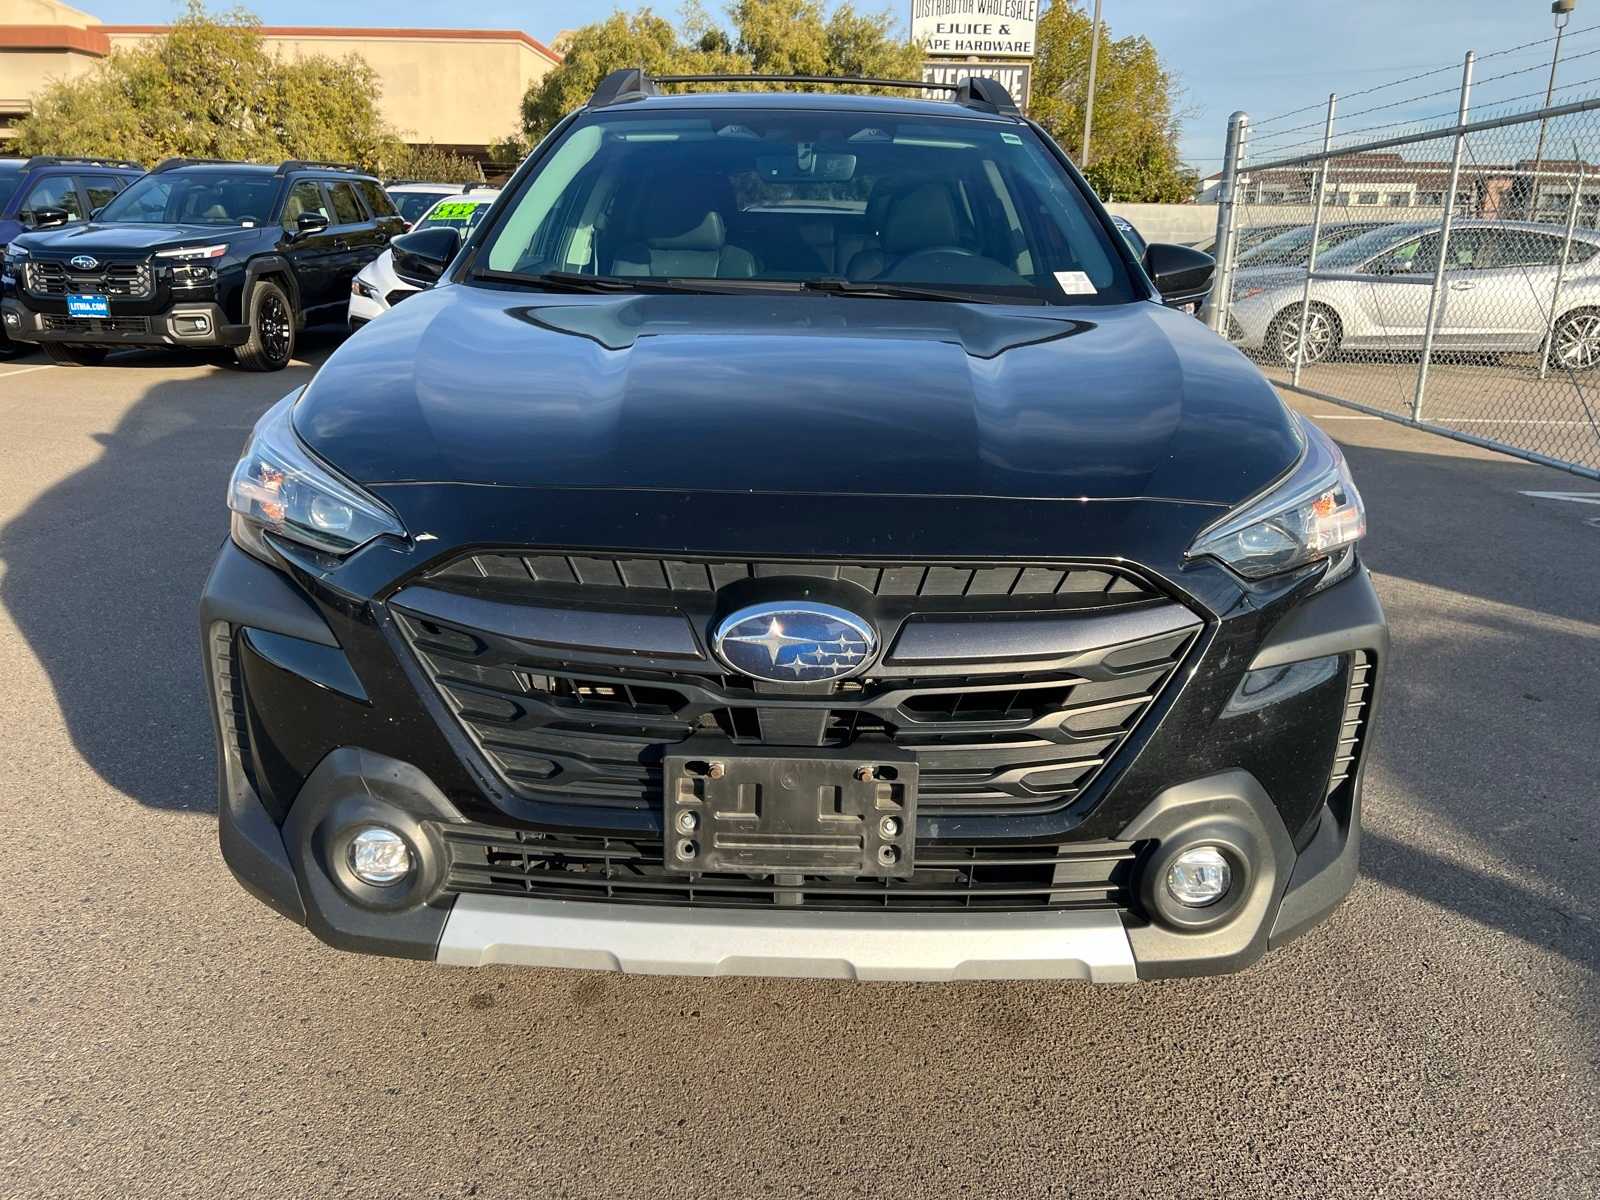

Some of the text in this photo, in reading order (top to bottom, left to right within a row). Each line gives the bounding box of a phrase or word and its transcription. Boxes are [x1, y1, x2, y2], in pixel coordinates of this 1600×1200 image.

[916, 0, 1035, 22] DISTRIBUTOR WHOLESALE
[936, 23, 1012, 36] EJUICE &
[955, 40, 1031, 52] HARDWARE
